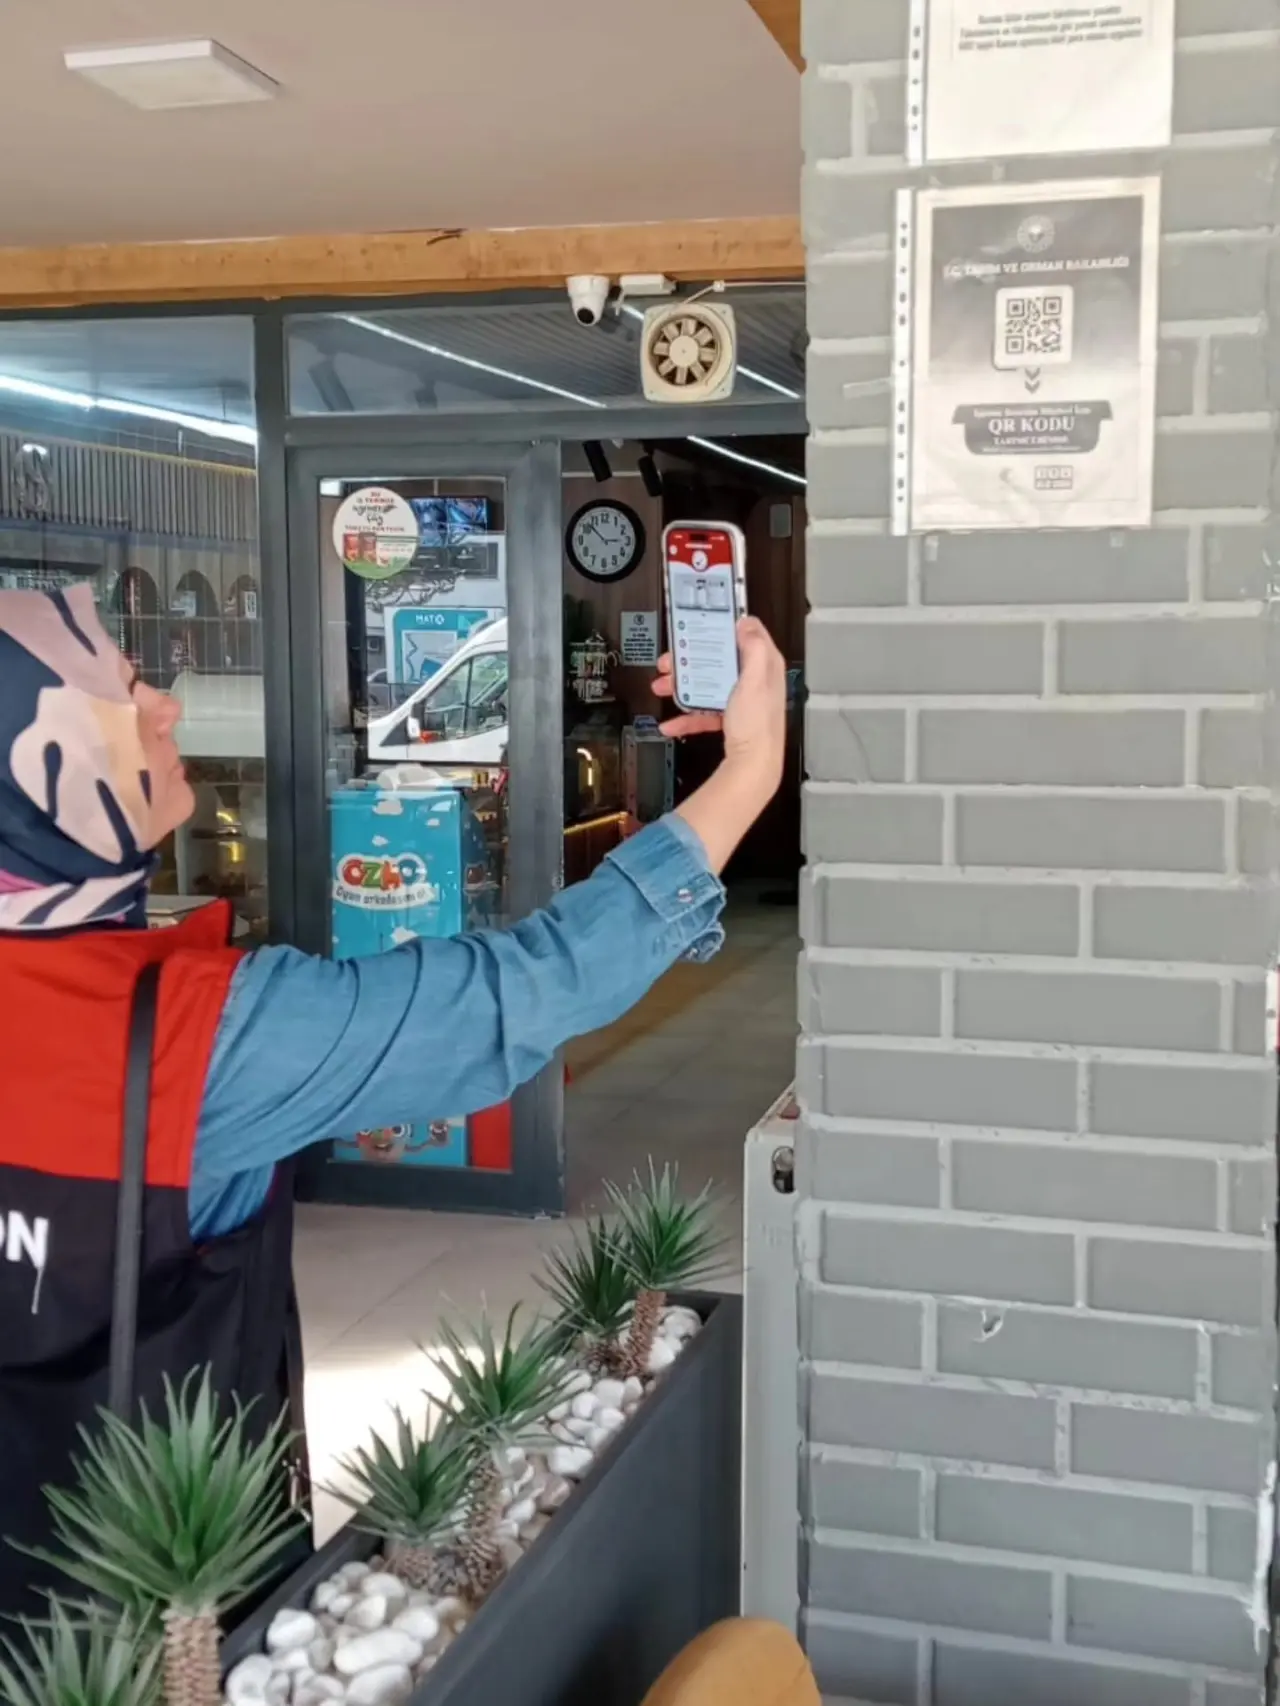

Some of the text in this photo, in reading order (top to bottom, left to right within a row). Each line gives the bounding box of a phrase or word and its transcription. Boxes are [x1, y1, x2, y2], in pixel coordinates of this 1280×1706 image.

[988, 415, 1076, 436] QR KODU
[600, 512, 610, 524] 12
[620, 524, 627, 536] 2
[624, 535, 632, 547] 3
[0, 1209, 50, 1274] N
